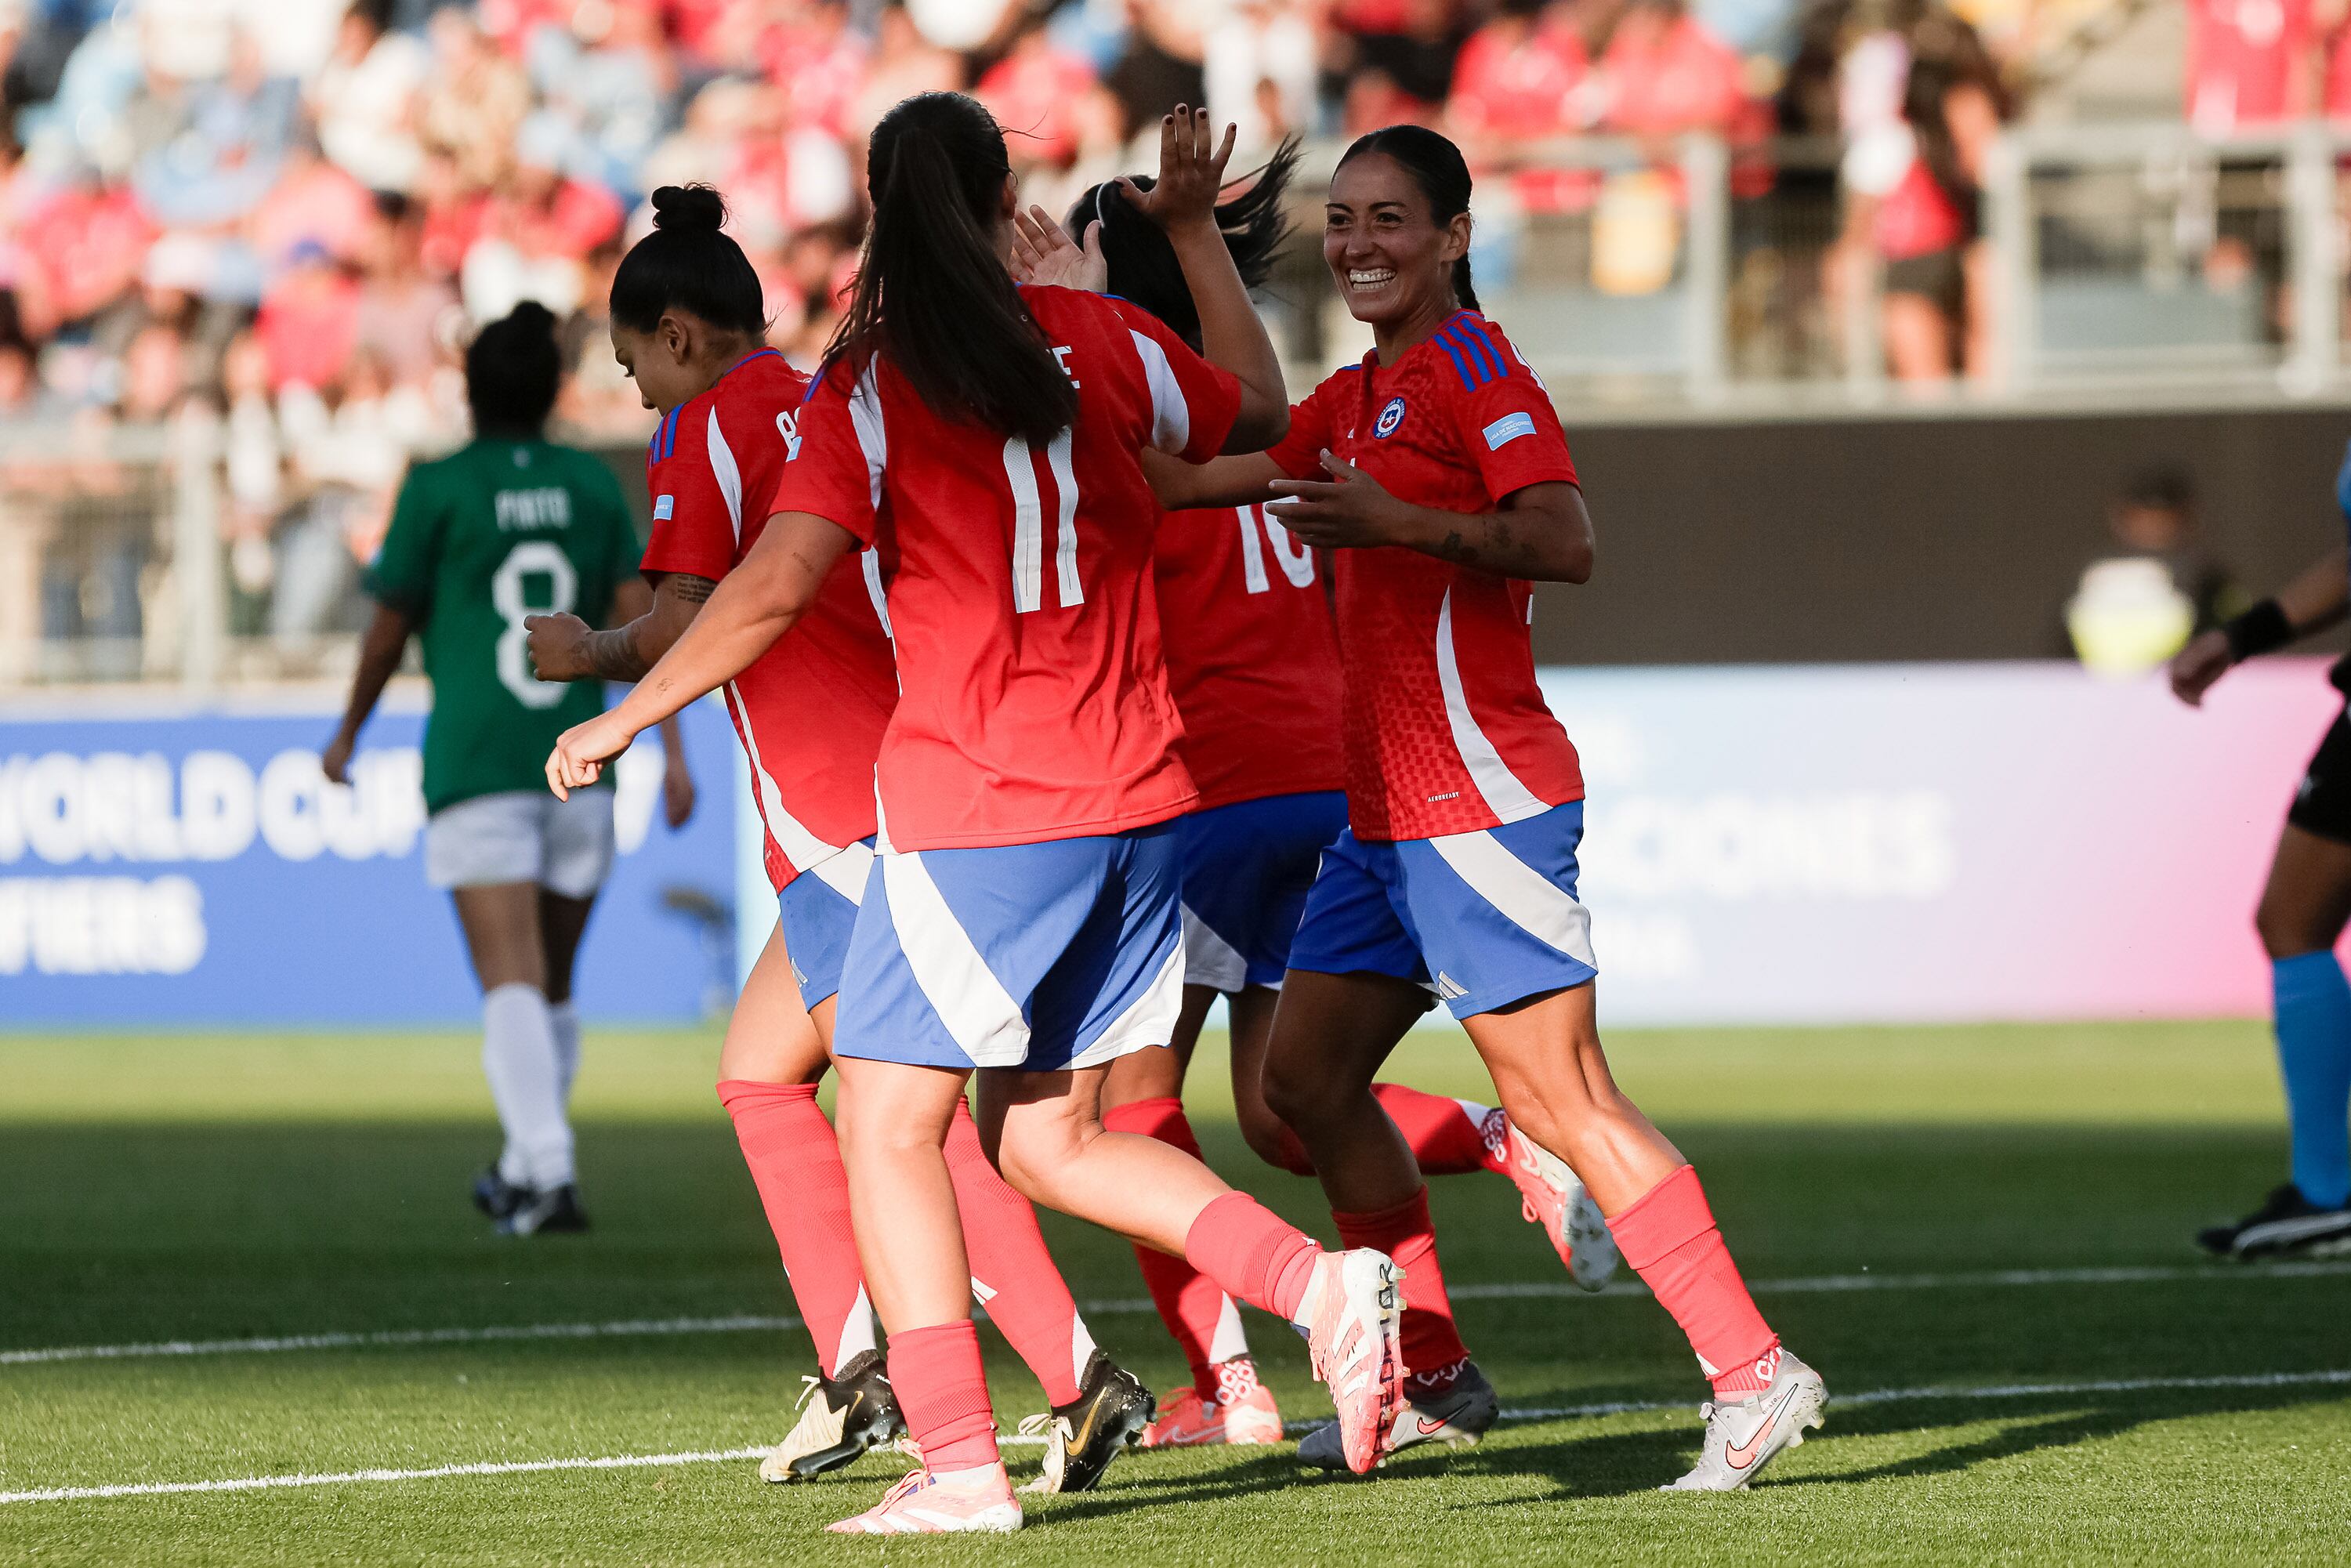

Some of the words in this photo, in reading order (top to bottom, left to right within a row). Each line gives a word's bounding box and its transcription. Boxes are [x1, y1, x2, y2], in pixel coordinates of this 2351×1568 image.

[1003, 425, 1085, 614] 11
[492, 541, 578, 709] 8
[1427, 791, 1460, 802] AEROREADY
